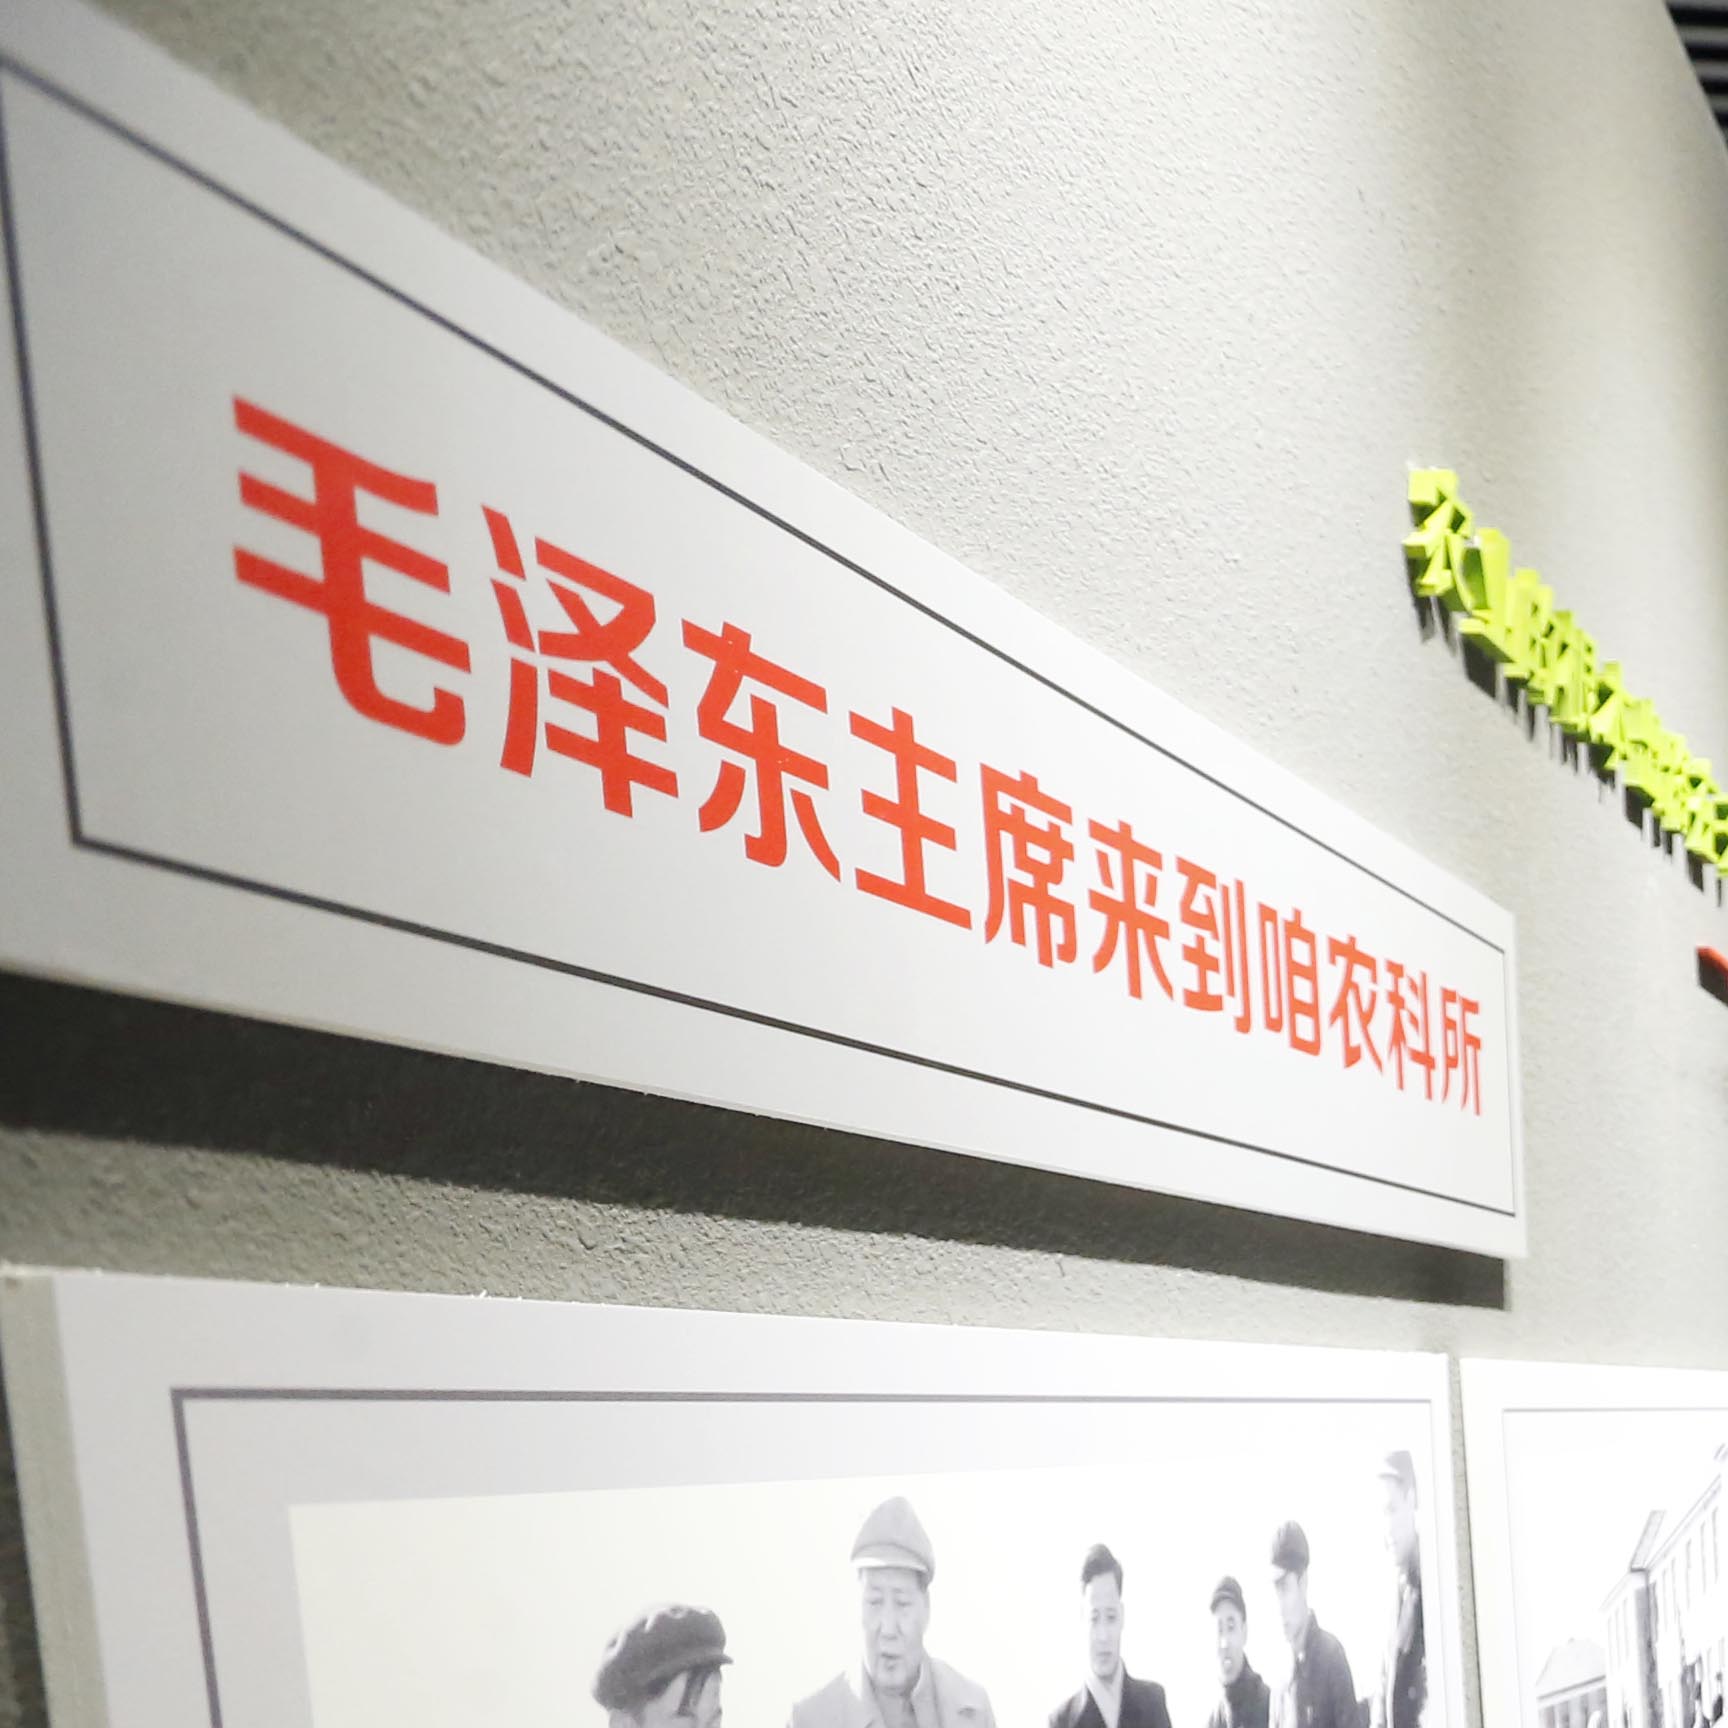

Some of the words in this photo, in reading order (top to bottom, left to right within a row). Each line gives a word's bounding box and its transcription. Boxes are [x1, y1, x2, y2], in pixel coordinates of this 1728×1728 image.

[232, 394, 1486, 1119] 毛泽东主席来到咱农科所
